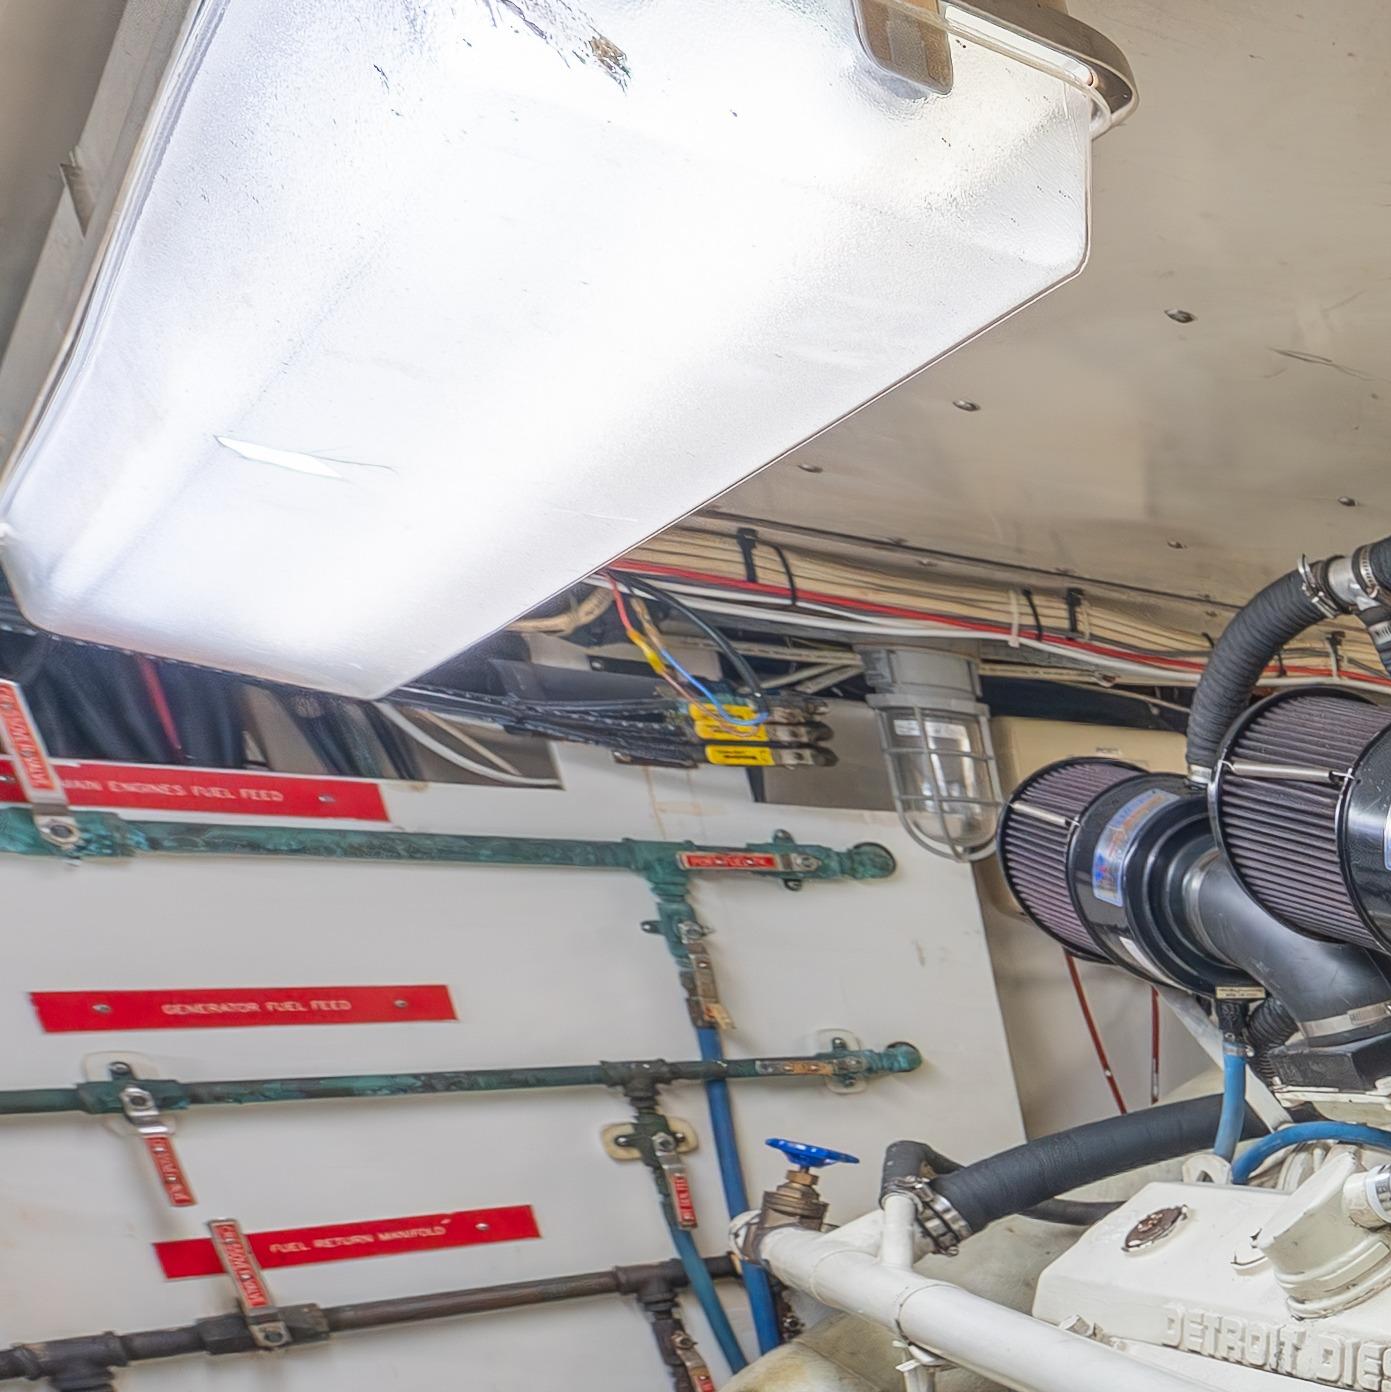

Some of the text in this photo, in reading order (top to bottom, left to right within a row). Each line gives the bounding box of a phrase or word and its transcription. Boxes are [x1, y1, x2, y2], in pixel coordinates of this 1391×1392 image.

[107, 780, 188, 797] ENGINES
[190, 785, 235, 800] FUEL
[240, 787, 285, 802] FEED
[160, 999, 353, 1016] GENERATOR FUEL FEED
[269, 1224, 447, 1255] FUEL RETURN MANIFOLD
[1162, 1302, 1306, 1376] DETROIT
